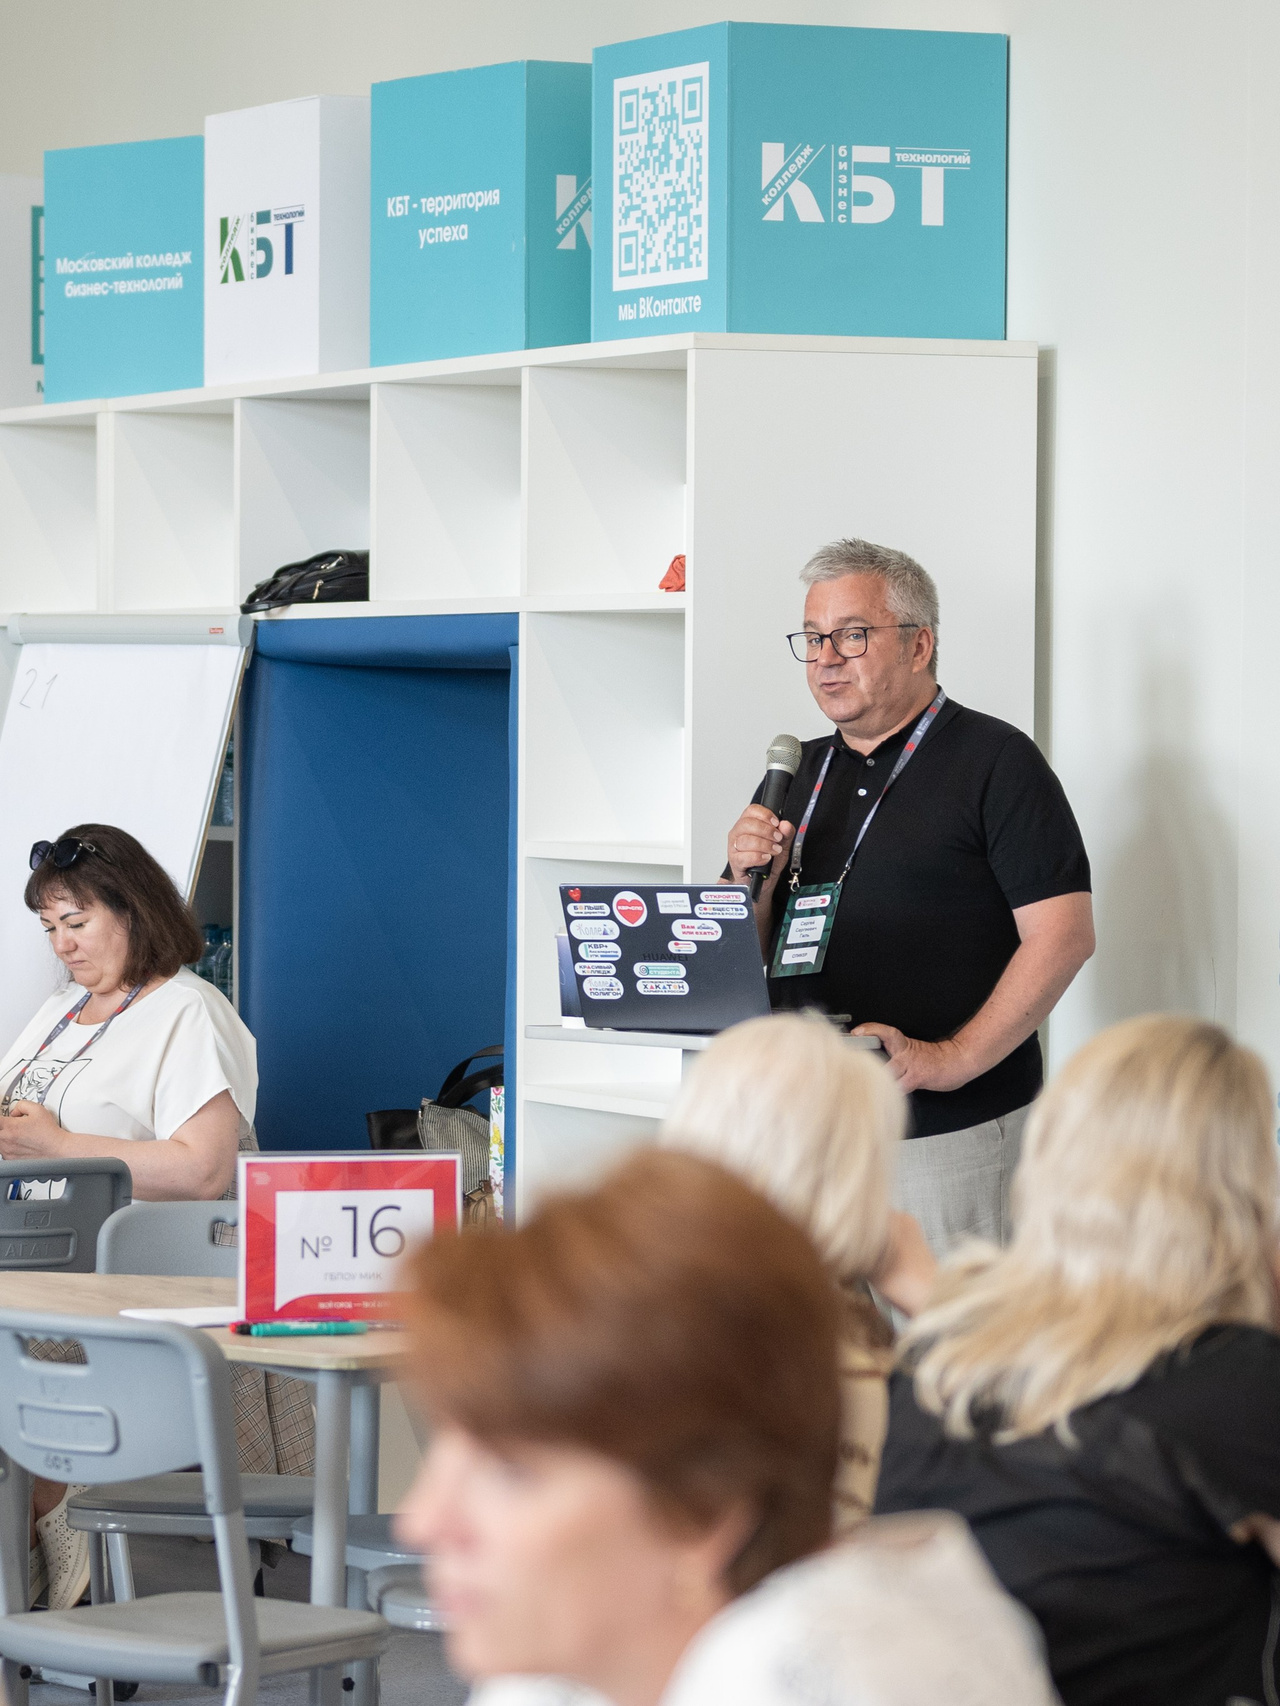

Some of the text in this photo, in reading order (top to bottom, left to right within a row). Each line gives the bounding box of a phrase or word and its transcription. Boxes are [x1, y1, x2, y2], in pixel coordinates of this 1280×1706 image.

[761, 144, 815, 206] колледж
[894, 152, 971, 165] технологий
[761, 141, 970, 227] КБТ
[837, 145, 848, 224] бизнес
[273, 206, 305, 222] технологий
[387, 195, 410, 218] КБТ
[420, 188, 501, 217] территория
[219, 217, 241, 271] колледж
[219, 204, 305, 285] КБТ
[418, 223, 469, 249] успеха
[55, 251, 192, 274] Московский колледж
[64, 272, 184, 298] бизнес-технологий
[618, 294, 702, 321] мы ВКонтакте
[19, 667, 58, 710] 21
[300, 1204, 406, 1259] № 16
